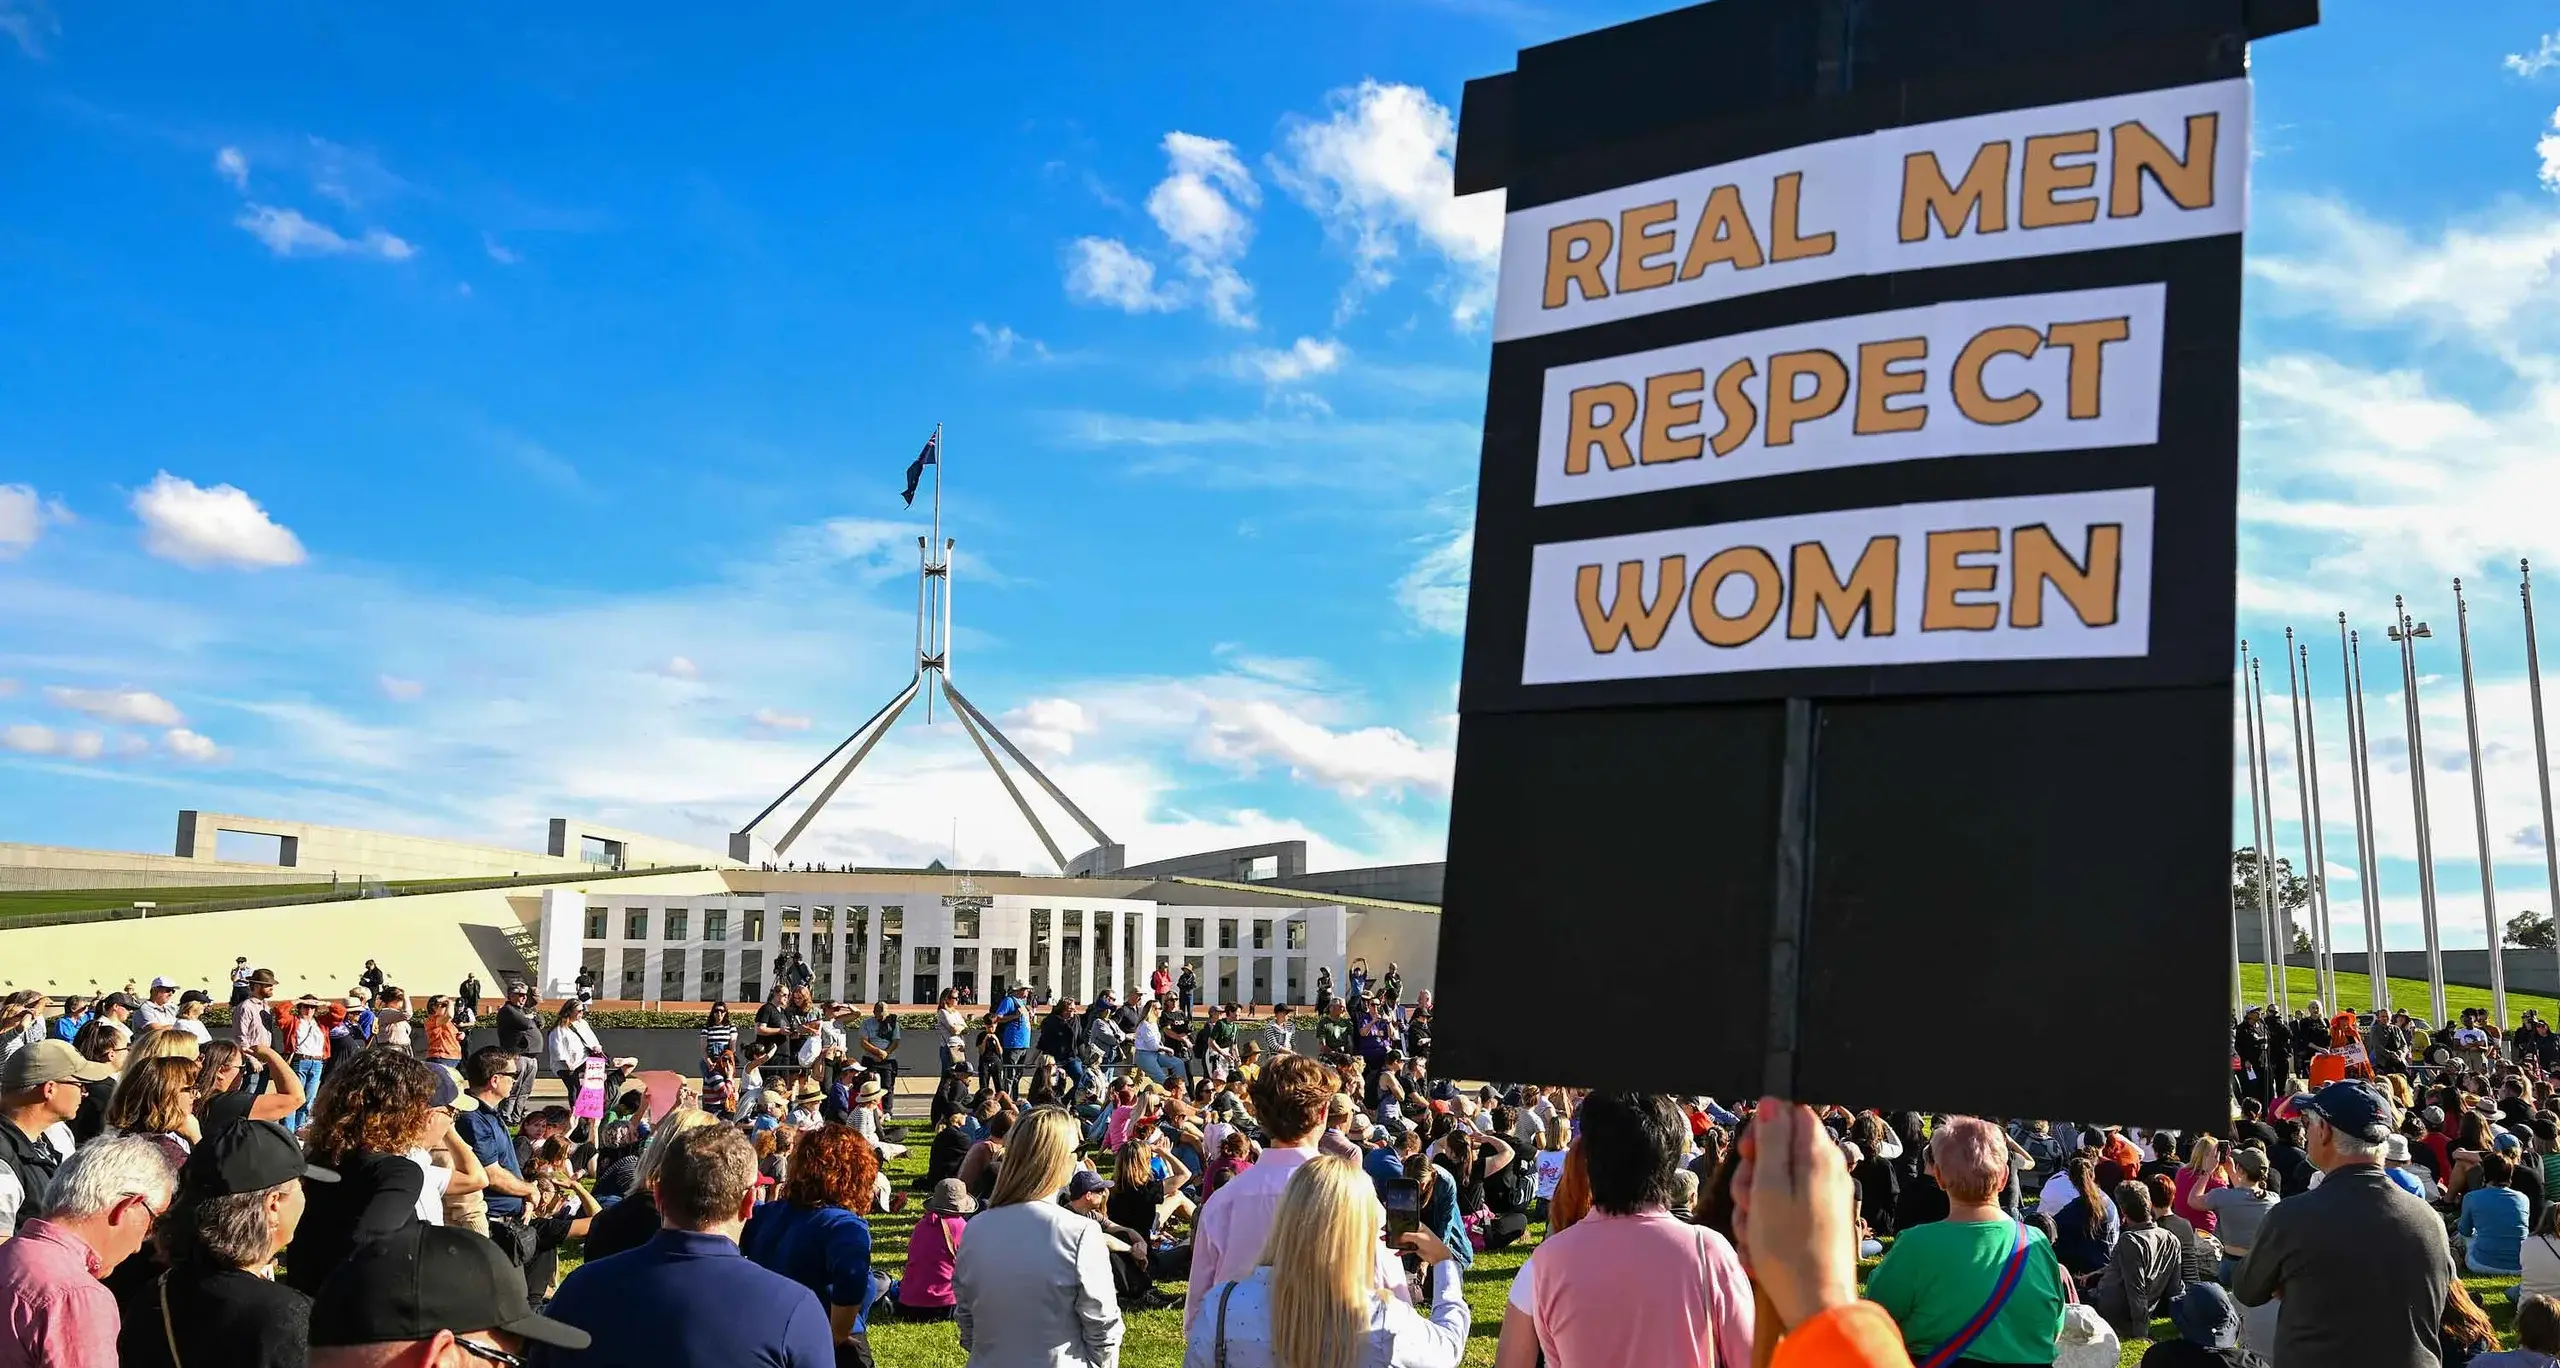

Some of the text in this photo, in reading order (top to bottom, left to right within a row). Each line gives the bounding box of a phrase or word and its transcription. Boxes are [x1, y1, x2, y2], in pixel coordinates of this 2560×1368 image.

[1542, 112, 2218, 310] REAL MEN
[1564, 317, 2130, 476] RESPECT
[1575, 523, 2122, 654] WOMEN
